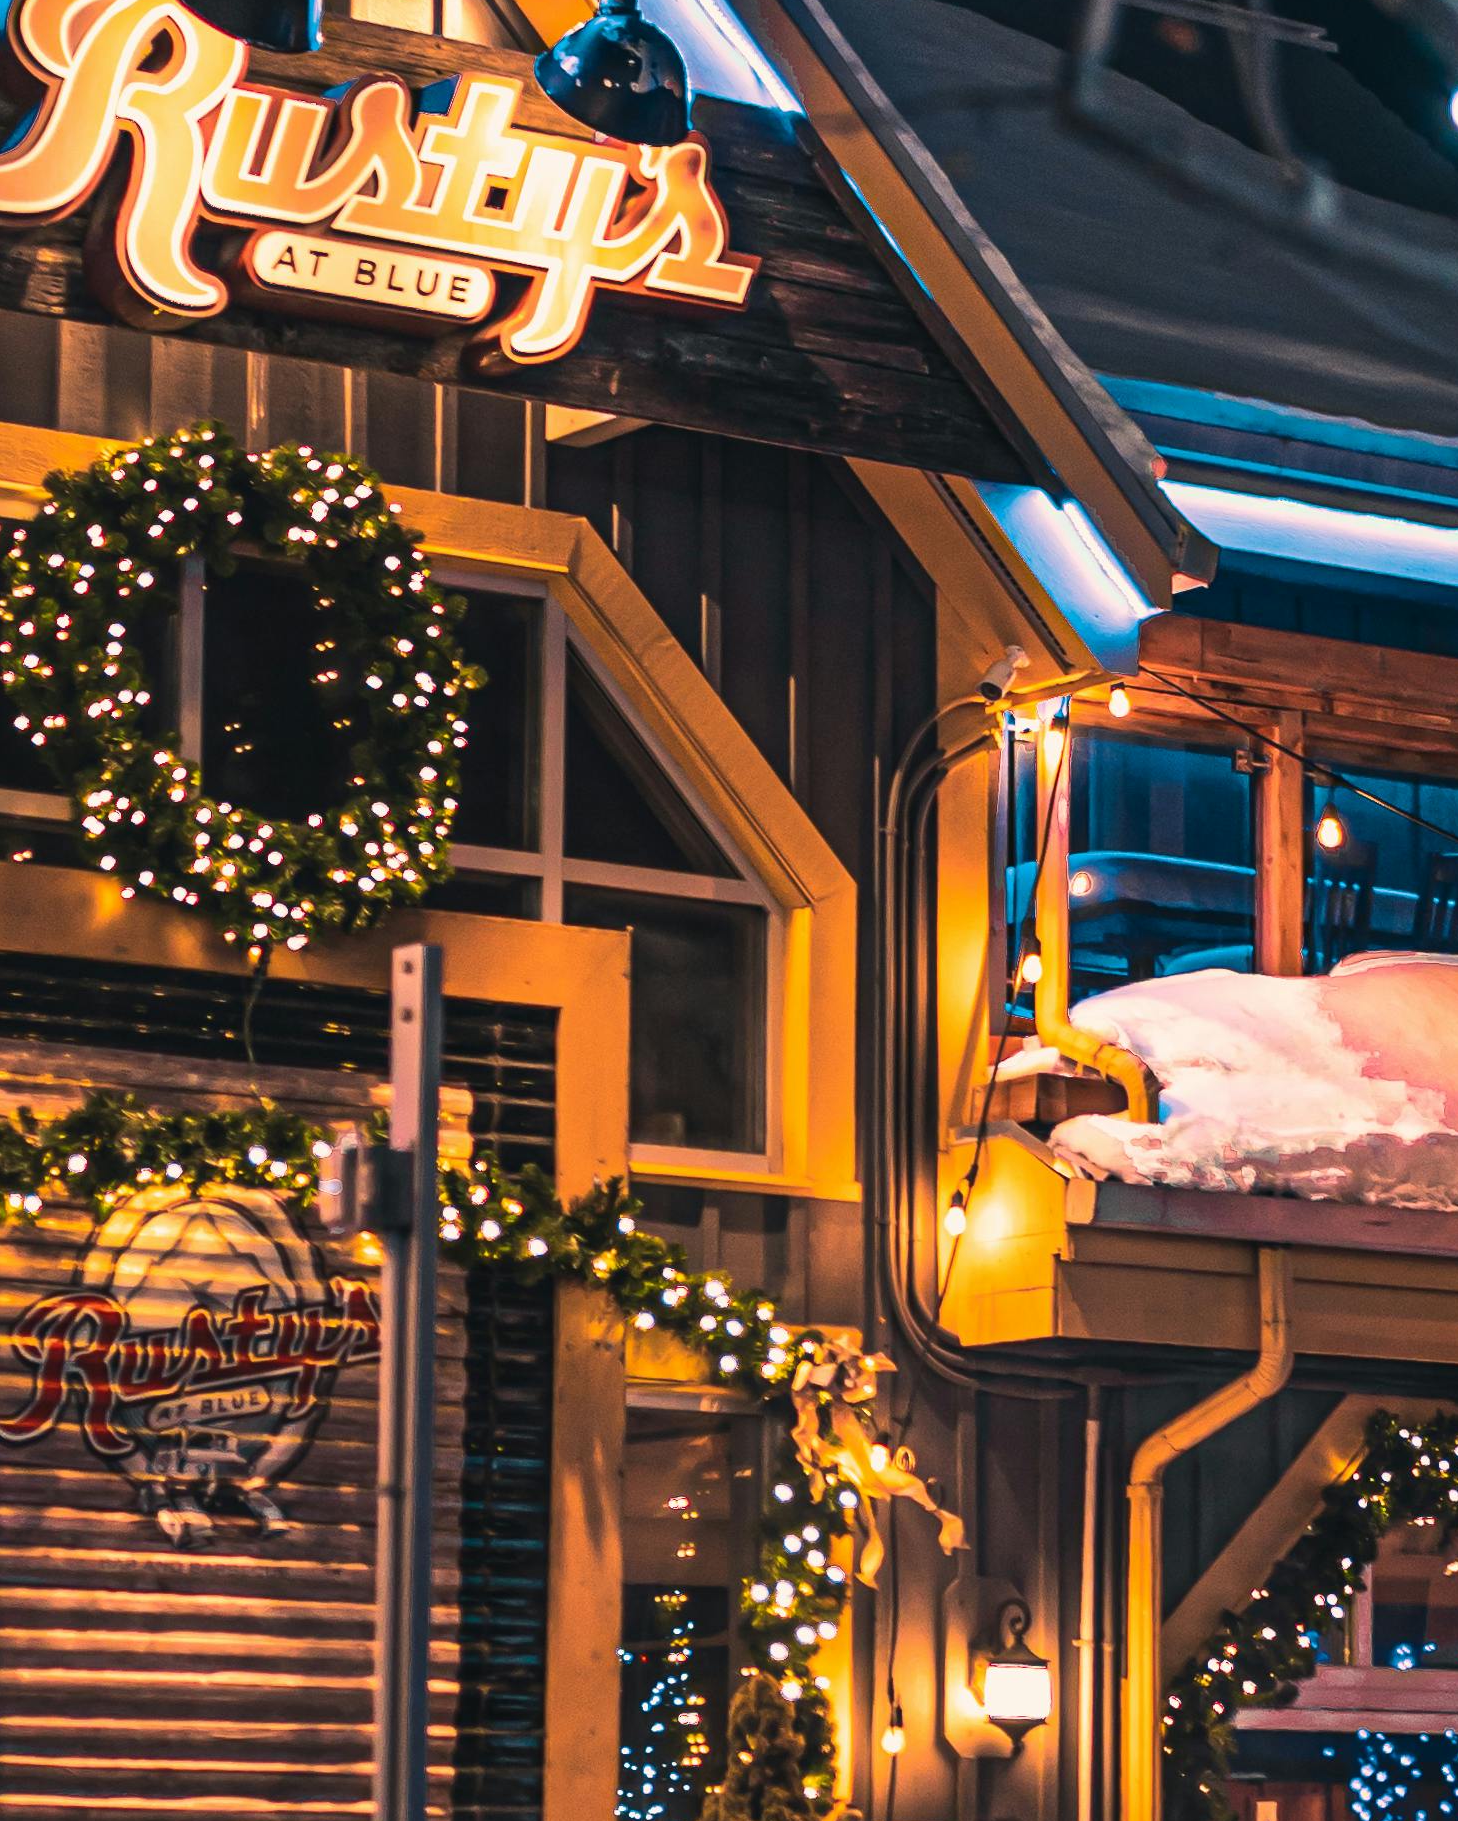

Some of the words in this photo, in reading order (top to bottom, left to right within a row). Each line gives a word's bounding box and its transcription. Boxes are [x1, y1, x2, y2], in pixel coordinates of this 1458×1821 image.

[271, 243, 331, 280] AT
[353, 258, 471, 303] BLUE
[156, 1403, 188, 1423] AT
[200, 1389, 261, 1415] BLUE
